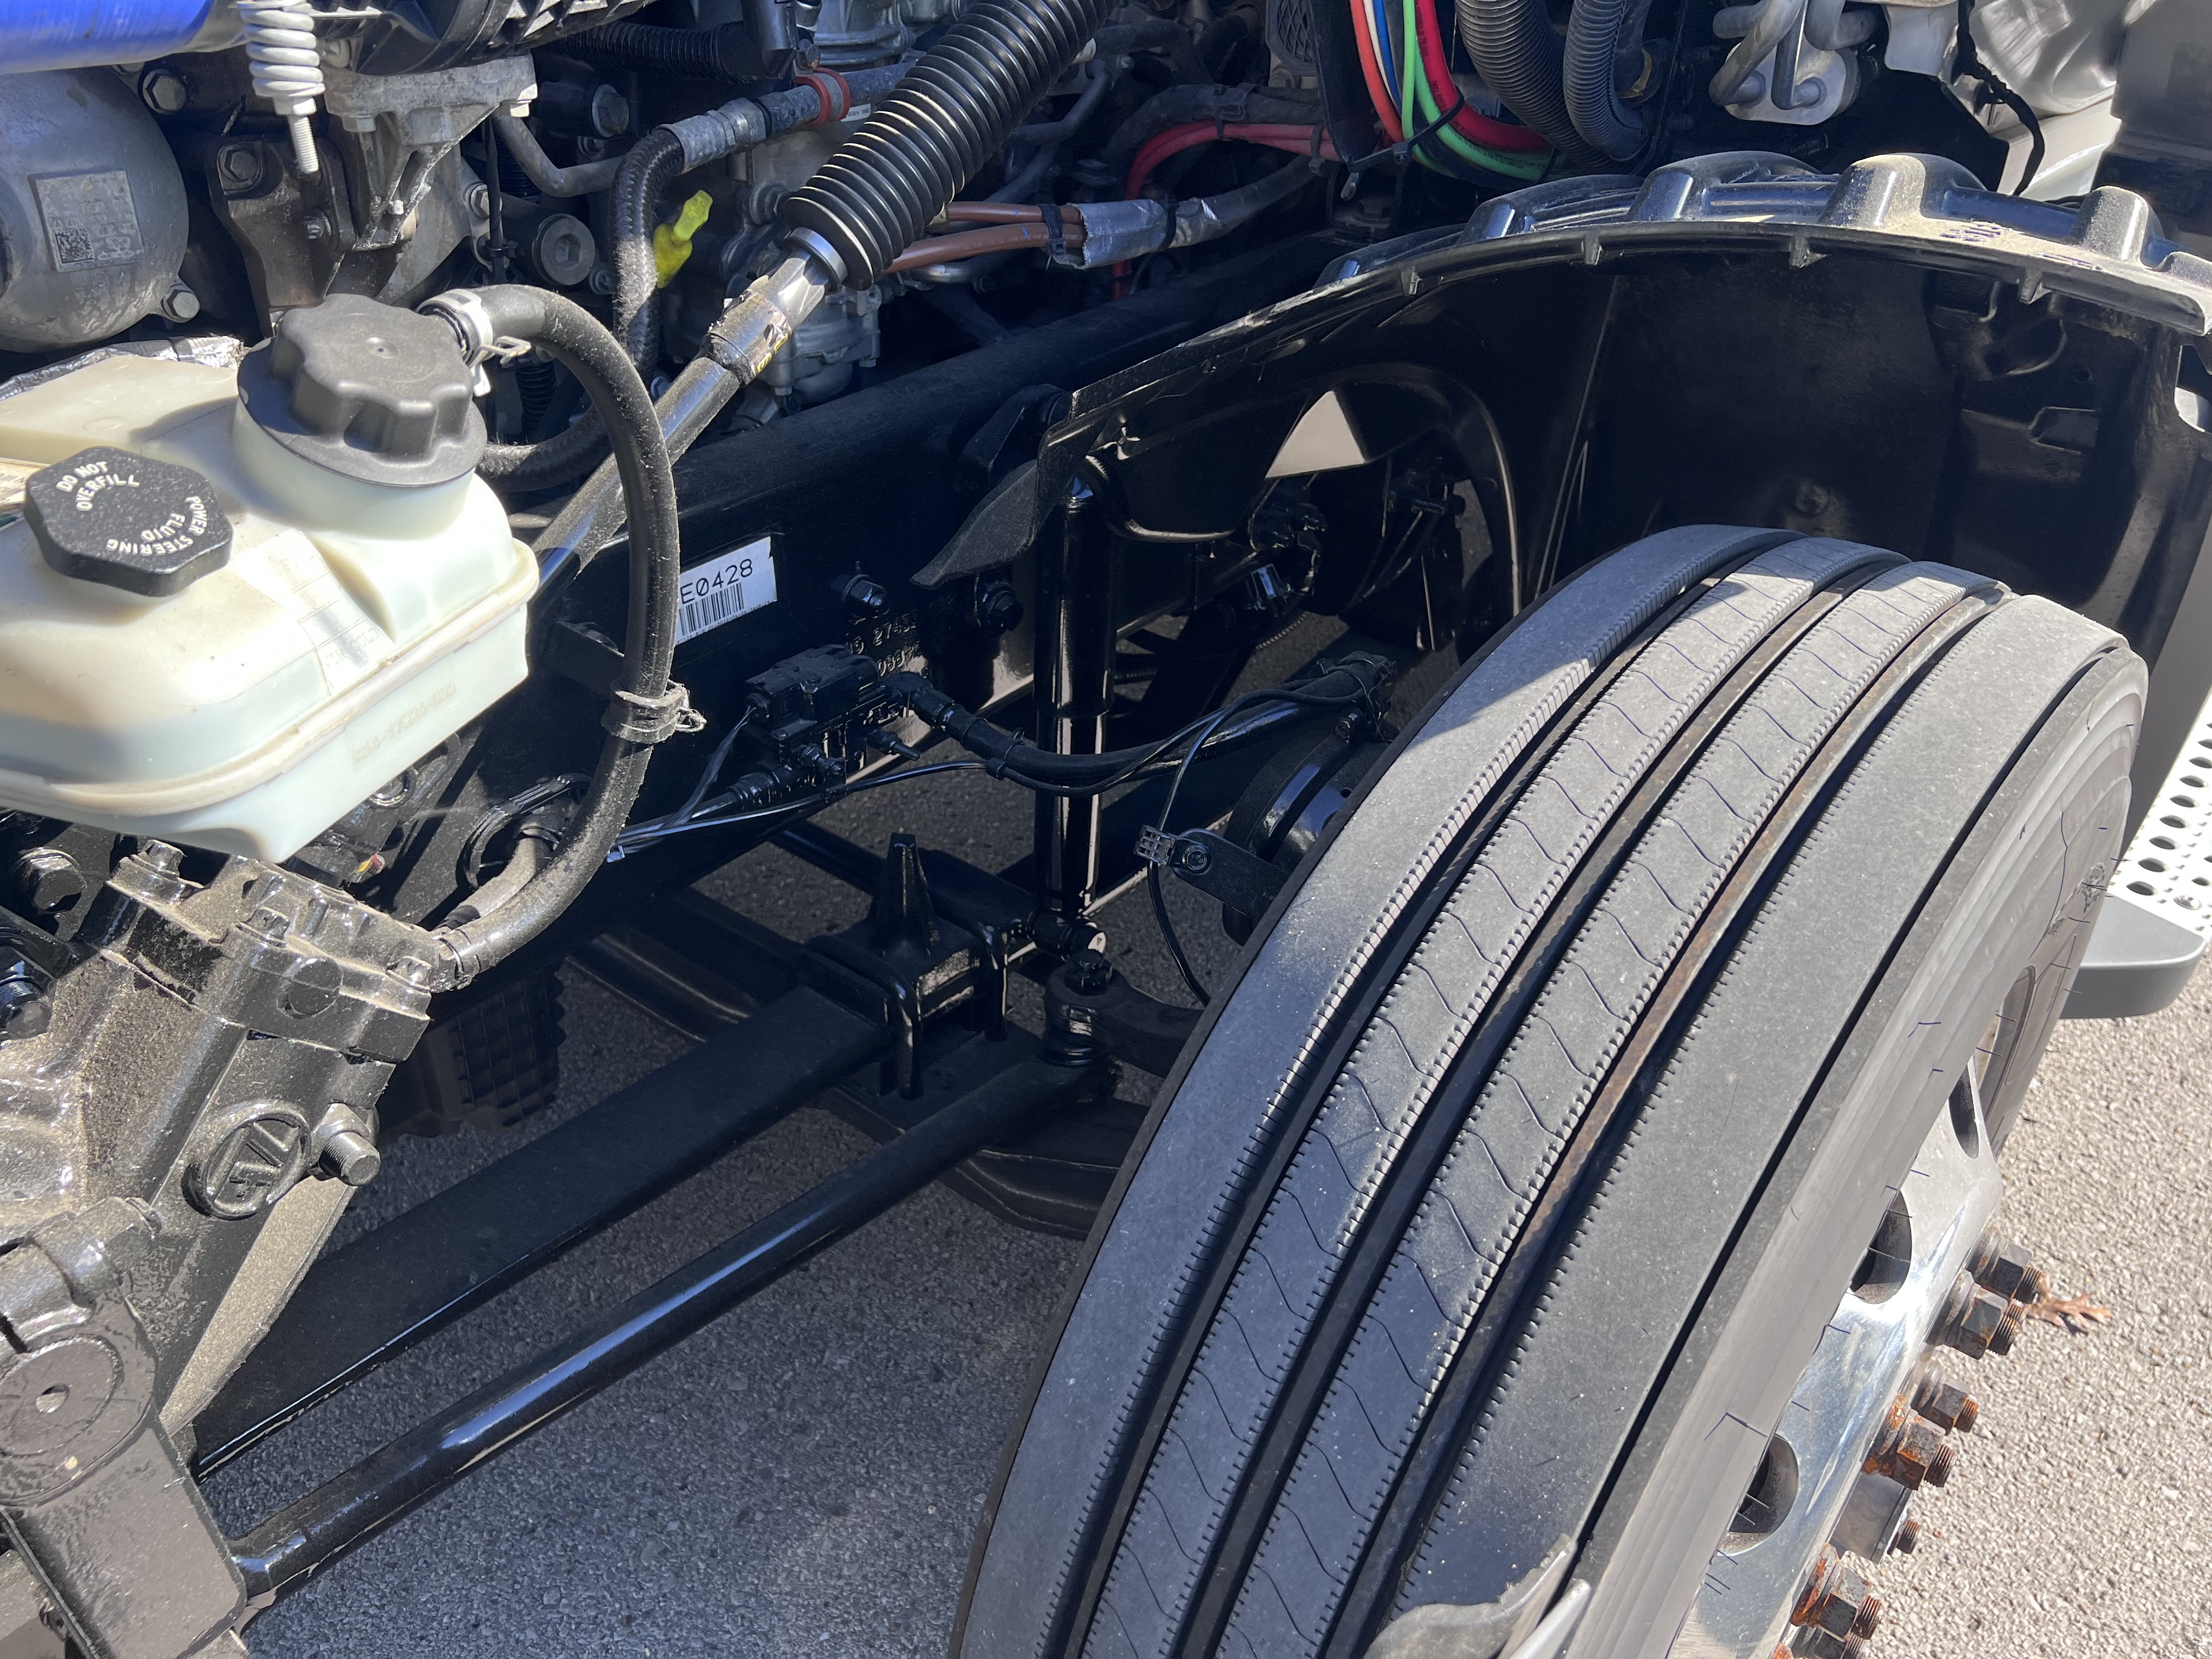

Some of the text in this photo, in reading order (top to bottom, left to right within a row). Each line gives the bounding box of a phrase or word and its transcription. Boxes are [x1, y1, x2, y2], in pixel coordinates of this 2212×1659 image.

[56, 461, 108, 493] DO NOT
[76, 473, 140, 511] OVERFILL
[106, 495, 208, 556] POWER STEERING
[140, 512, 186, 543] FLUID
[680, 558, 753, 605] E0428
